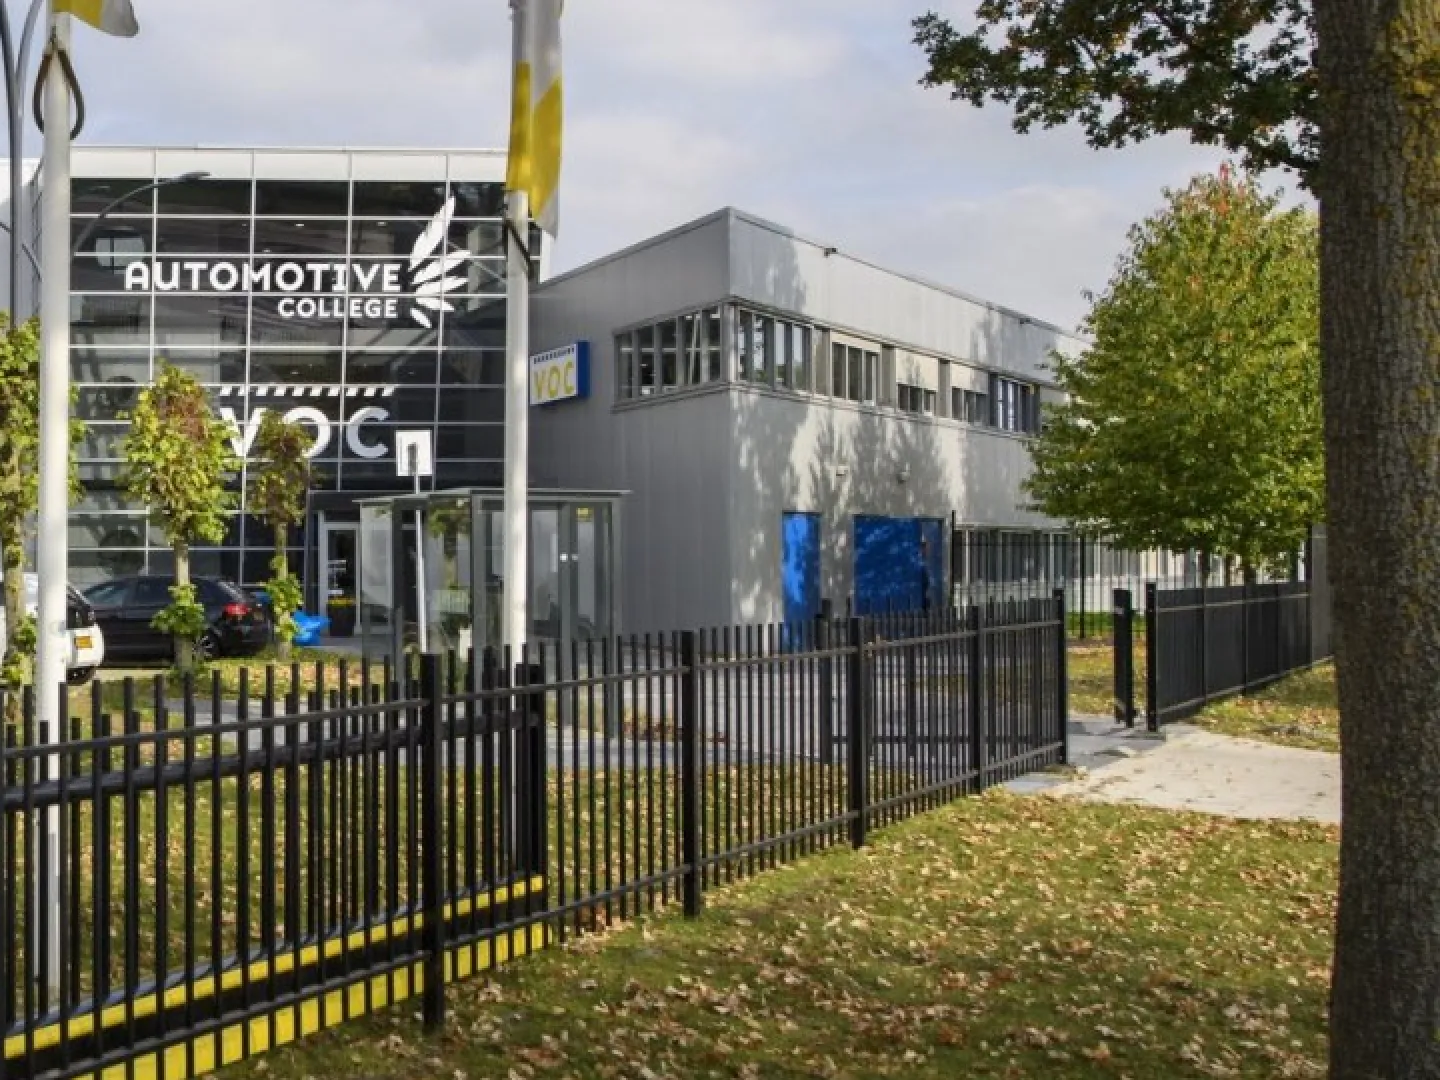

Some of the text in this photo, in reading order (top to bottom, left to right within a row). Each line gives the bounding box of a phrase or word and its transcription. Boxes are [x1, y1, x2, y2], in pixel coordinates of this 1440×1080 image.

[125, 261, 401, 291] AUTOMOTIVE
[278, 298, 398, 318] COLLEGE
[534, 358, 574, 400] VOC
[220, 407, 390, 458] VOC
